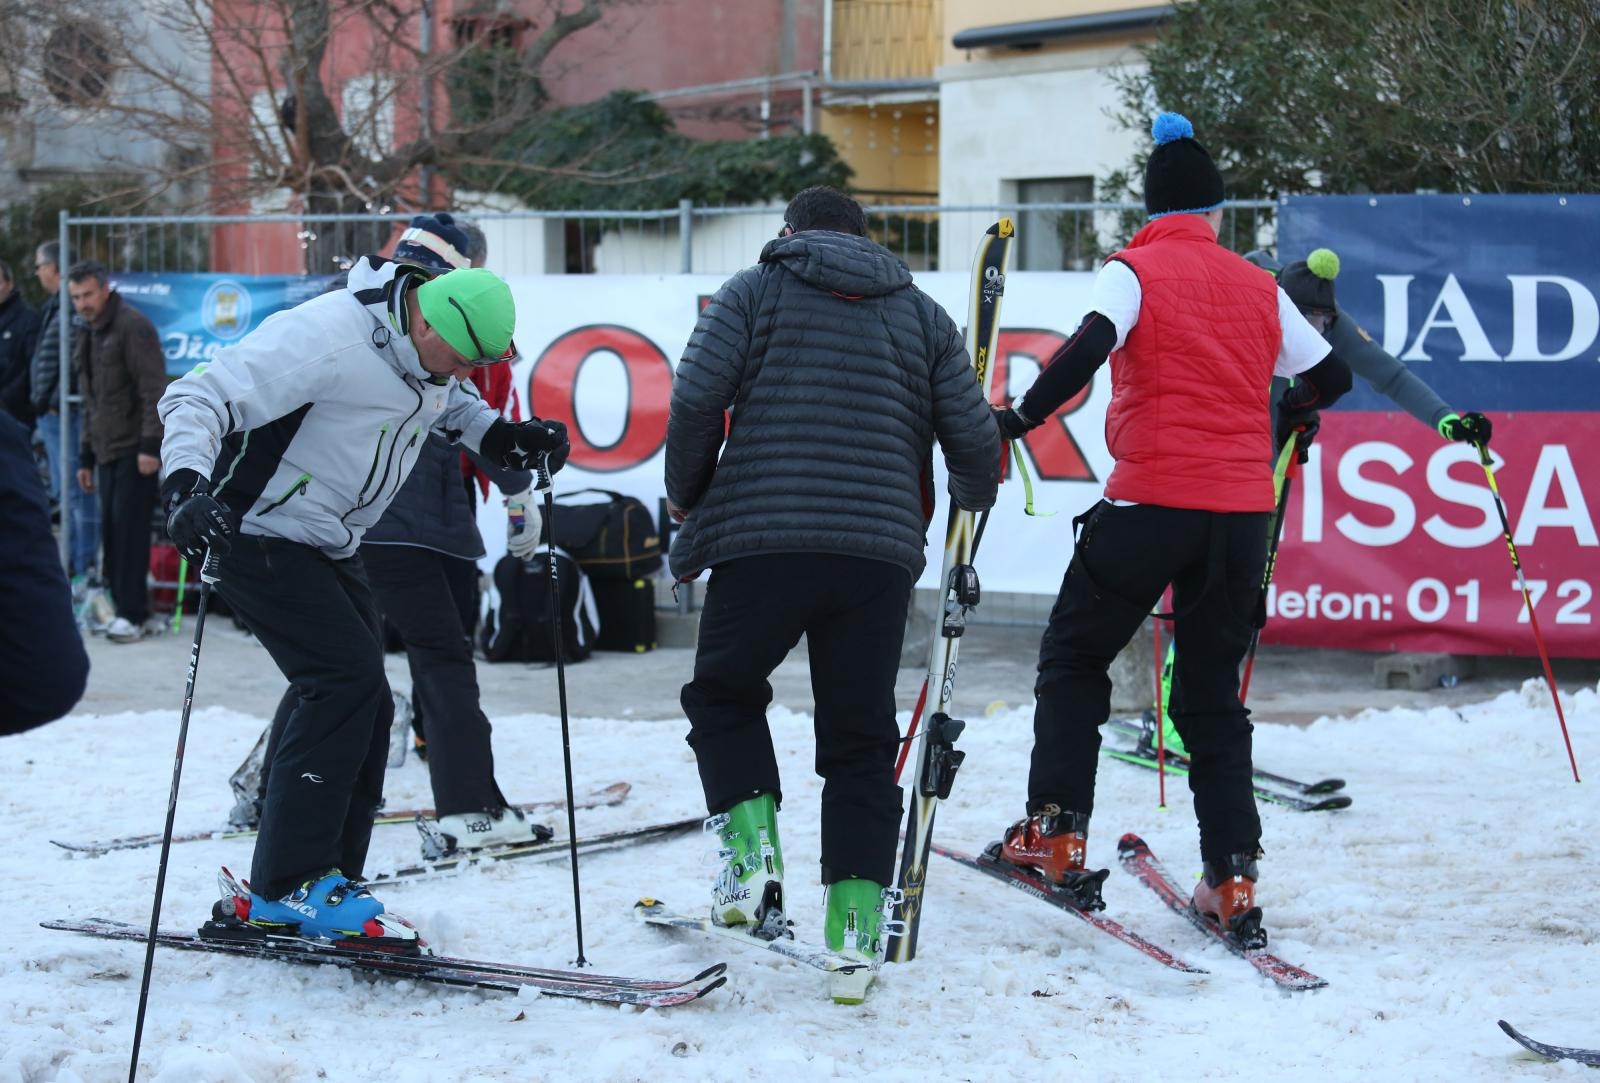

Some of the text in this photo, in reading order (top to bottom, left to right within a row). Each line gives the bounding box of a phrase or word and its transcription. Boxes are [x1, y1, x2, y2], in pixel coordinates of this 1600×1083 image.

[1375, 272, 1600, 363] JAD
[1279, 440, 1600, 549] ISSA
[209, 509, 232, 535] LEKI
[548, 548, 559, 580] LEKI
[1406, 577, 1481, 624] 01
[1512, 578, 1593, 625] 72
[464, 817, 493, 834] head
[719, 888, 752, 906] LANGE
[1009, 878, 1048, 901] ATOMIC
